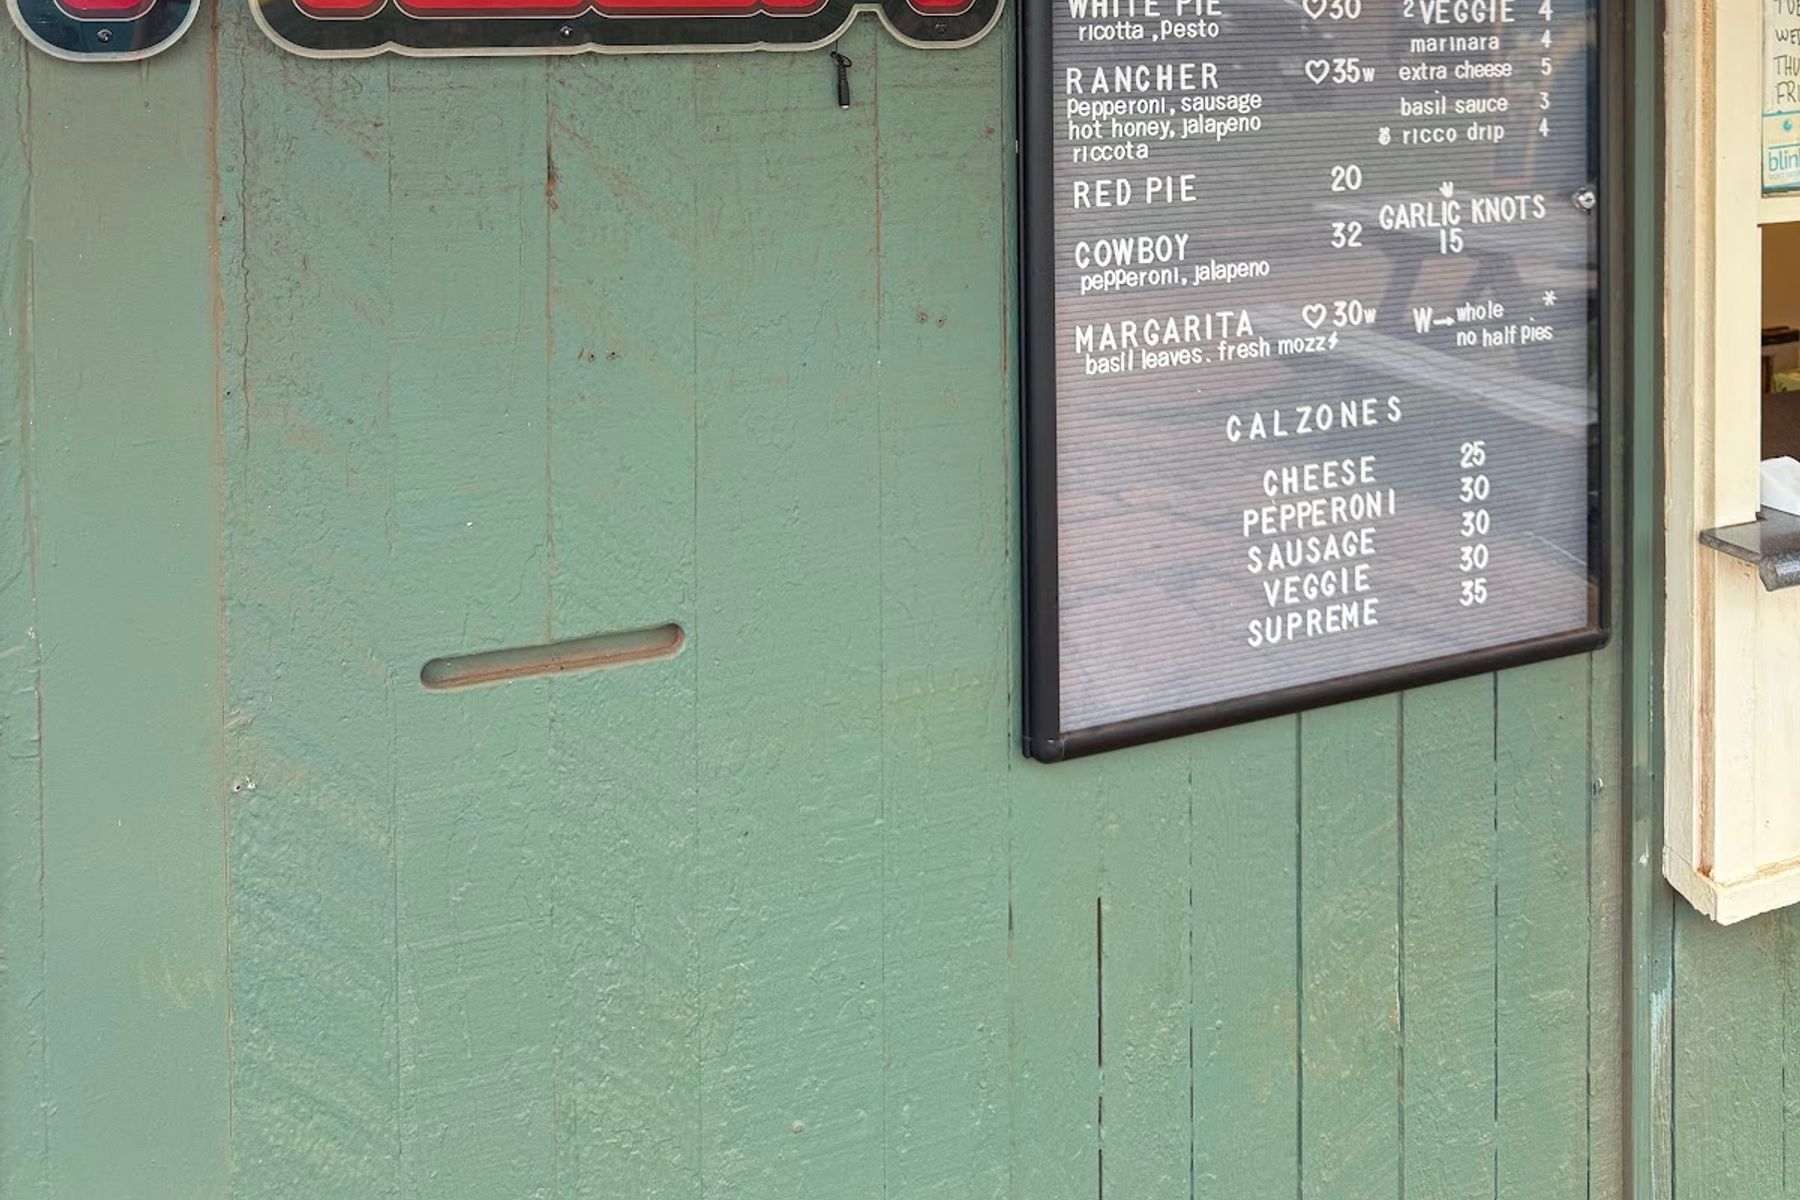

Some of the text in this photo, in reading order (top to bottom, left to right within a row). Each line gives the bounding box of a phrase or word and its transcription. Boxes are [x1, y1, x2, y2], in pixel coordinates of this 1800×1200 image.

[1078, 20, 1145, 42] ricotta
[1410, 29, 1553, 54] marinara 4
[1066, 63, 1219, 95] RANCHER
[1398, 56, 1553, 82] extra cheese 5
[1180, 92, 1263, 114] sausage
[1400, 89, 1550, 117] basil sauce 3
[1068, 118, 1103, 141] hot
[1180, 113, 1262, 142] jalapeno
[1402, 116, 1550, 145] ricco drip 4
[1072, 140, 1149, 163] riccota
[1073, 164, 1363, 209] RED PIE 20
[1378, 193, 1547, 231] GARLIC KNOTS
[1074, 221, 1363, 270] COWBOY 32
[1439, 227, 1464, 254] 15
[1191, 259, 1270, 287] jalapeno
[1455, 299, 1504, 323] whole
[1074, 308, 1255, 354] MARGARITA
[1456, 316, 1554, 348] no half pies
[1085, 347, 1134, 376] basil
[1217, 336, 1270, 362] fresh
[1225, 395, 1402, 443] CALZONES
[1262, 440, 1487, 498] CHEESE 25
[1242, 474, 1490, 538] PEPPERONI 30
[1247, 508, 1491, 575] SAUSAGE 30
[1263, 543, 1490, 608] VEGGIE 30
[1247, 577, 1488, 649] SUPREME 35
